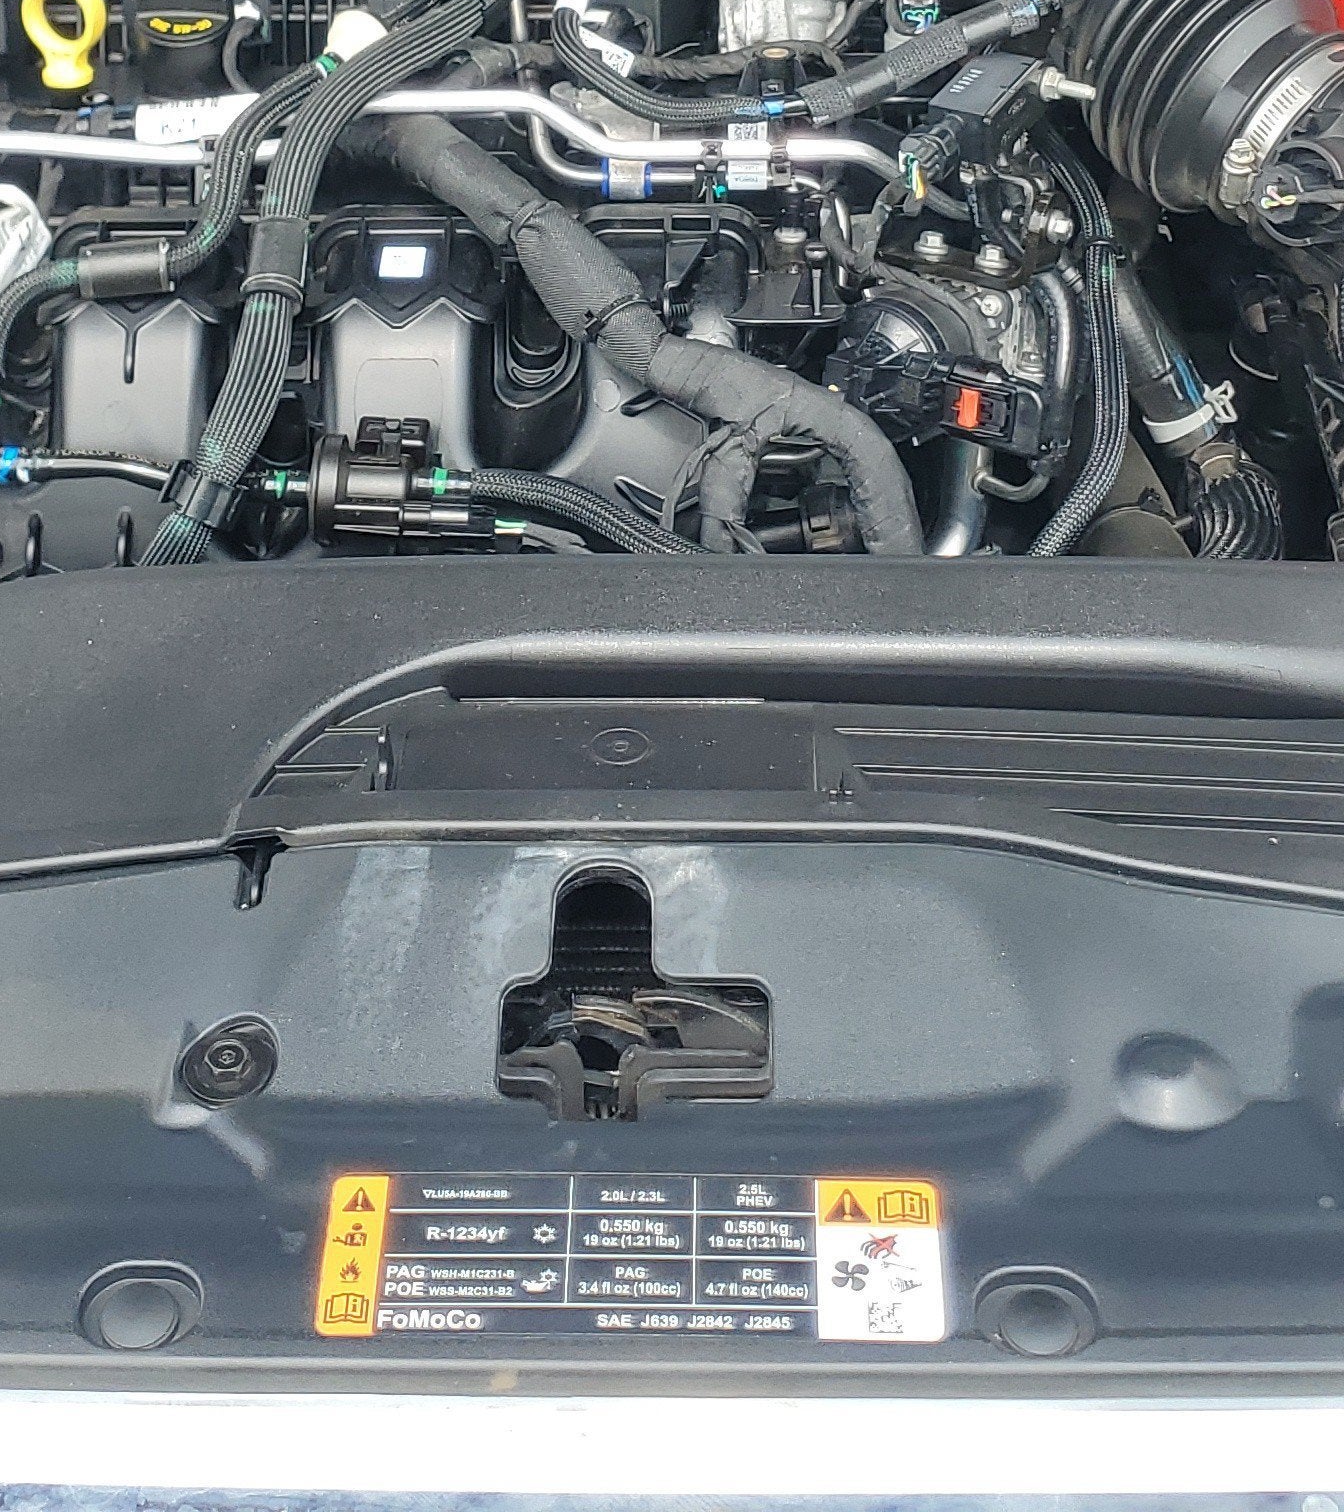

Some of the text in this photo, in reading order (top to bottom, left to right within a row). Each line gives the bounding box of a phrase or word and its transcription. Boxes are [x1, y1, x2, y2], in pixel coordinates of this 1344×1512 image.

[600, 1190, 629, 1202] 2.0L
[637, 1190, 666, 1202] 2.3L
[738, 1184, 767, 1195] 2.5L
[736, 1195, 774, 1206] PHEV
[599, 1218, 665, 1235] 0.550 kg
[724, 1220, 789, 1236] 0.550 kg
[426, 1226, 508, 1244] R-1234yf
[602, 1236, 618, 1246] oz
[620, 1234, 651, 1249] (1.21
[655, 1234, 680, 1249] lbs)
[727, 1238, 744, 1248] oz
[746, 1236, 777, 1251] (1.21
[781, 1236, 805, 1251] lbs)
[386, 1265, 425, 1279] PAG
[384, 1281, 425, 1296] POE
[578, 1281, 599, 1294] 3.4
[614, 1284, 630, 1294] oz
[633, 1281, 681, 1298] (100cc)
[705, 1283, 727, 1296] 4.7
[741, 1285, 758, 1296] oz
[761, 1283, 809, 1299] (140cc)
[376, 1308, 481, 1330] FoMoCo
[597, 1313, 791, 1329] SAE J639 J2842 J2845
